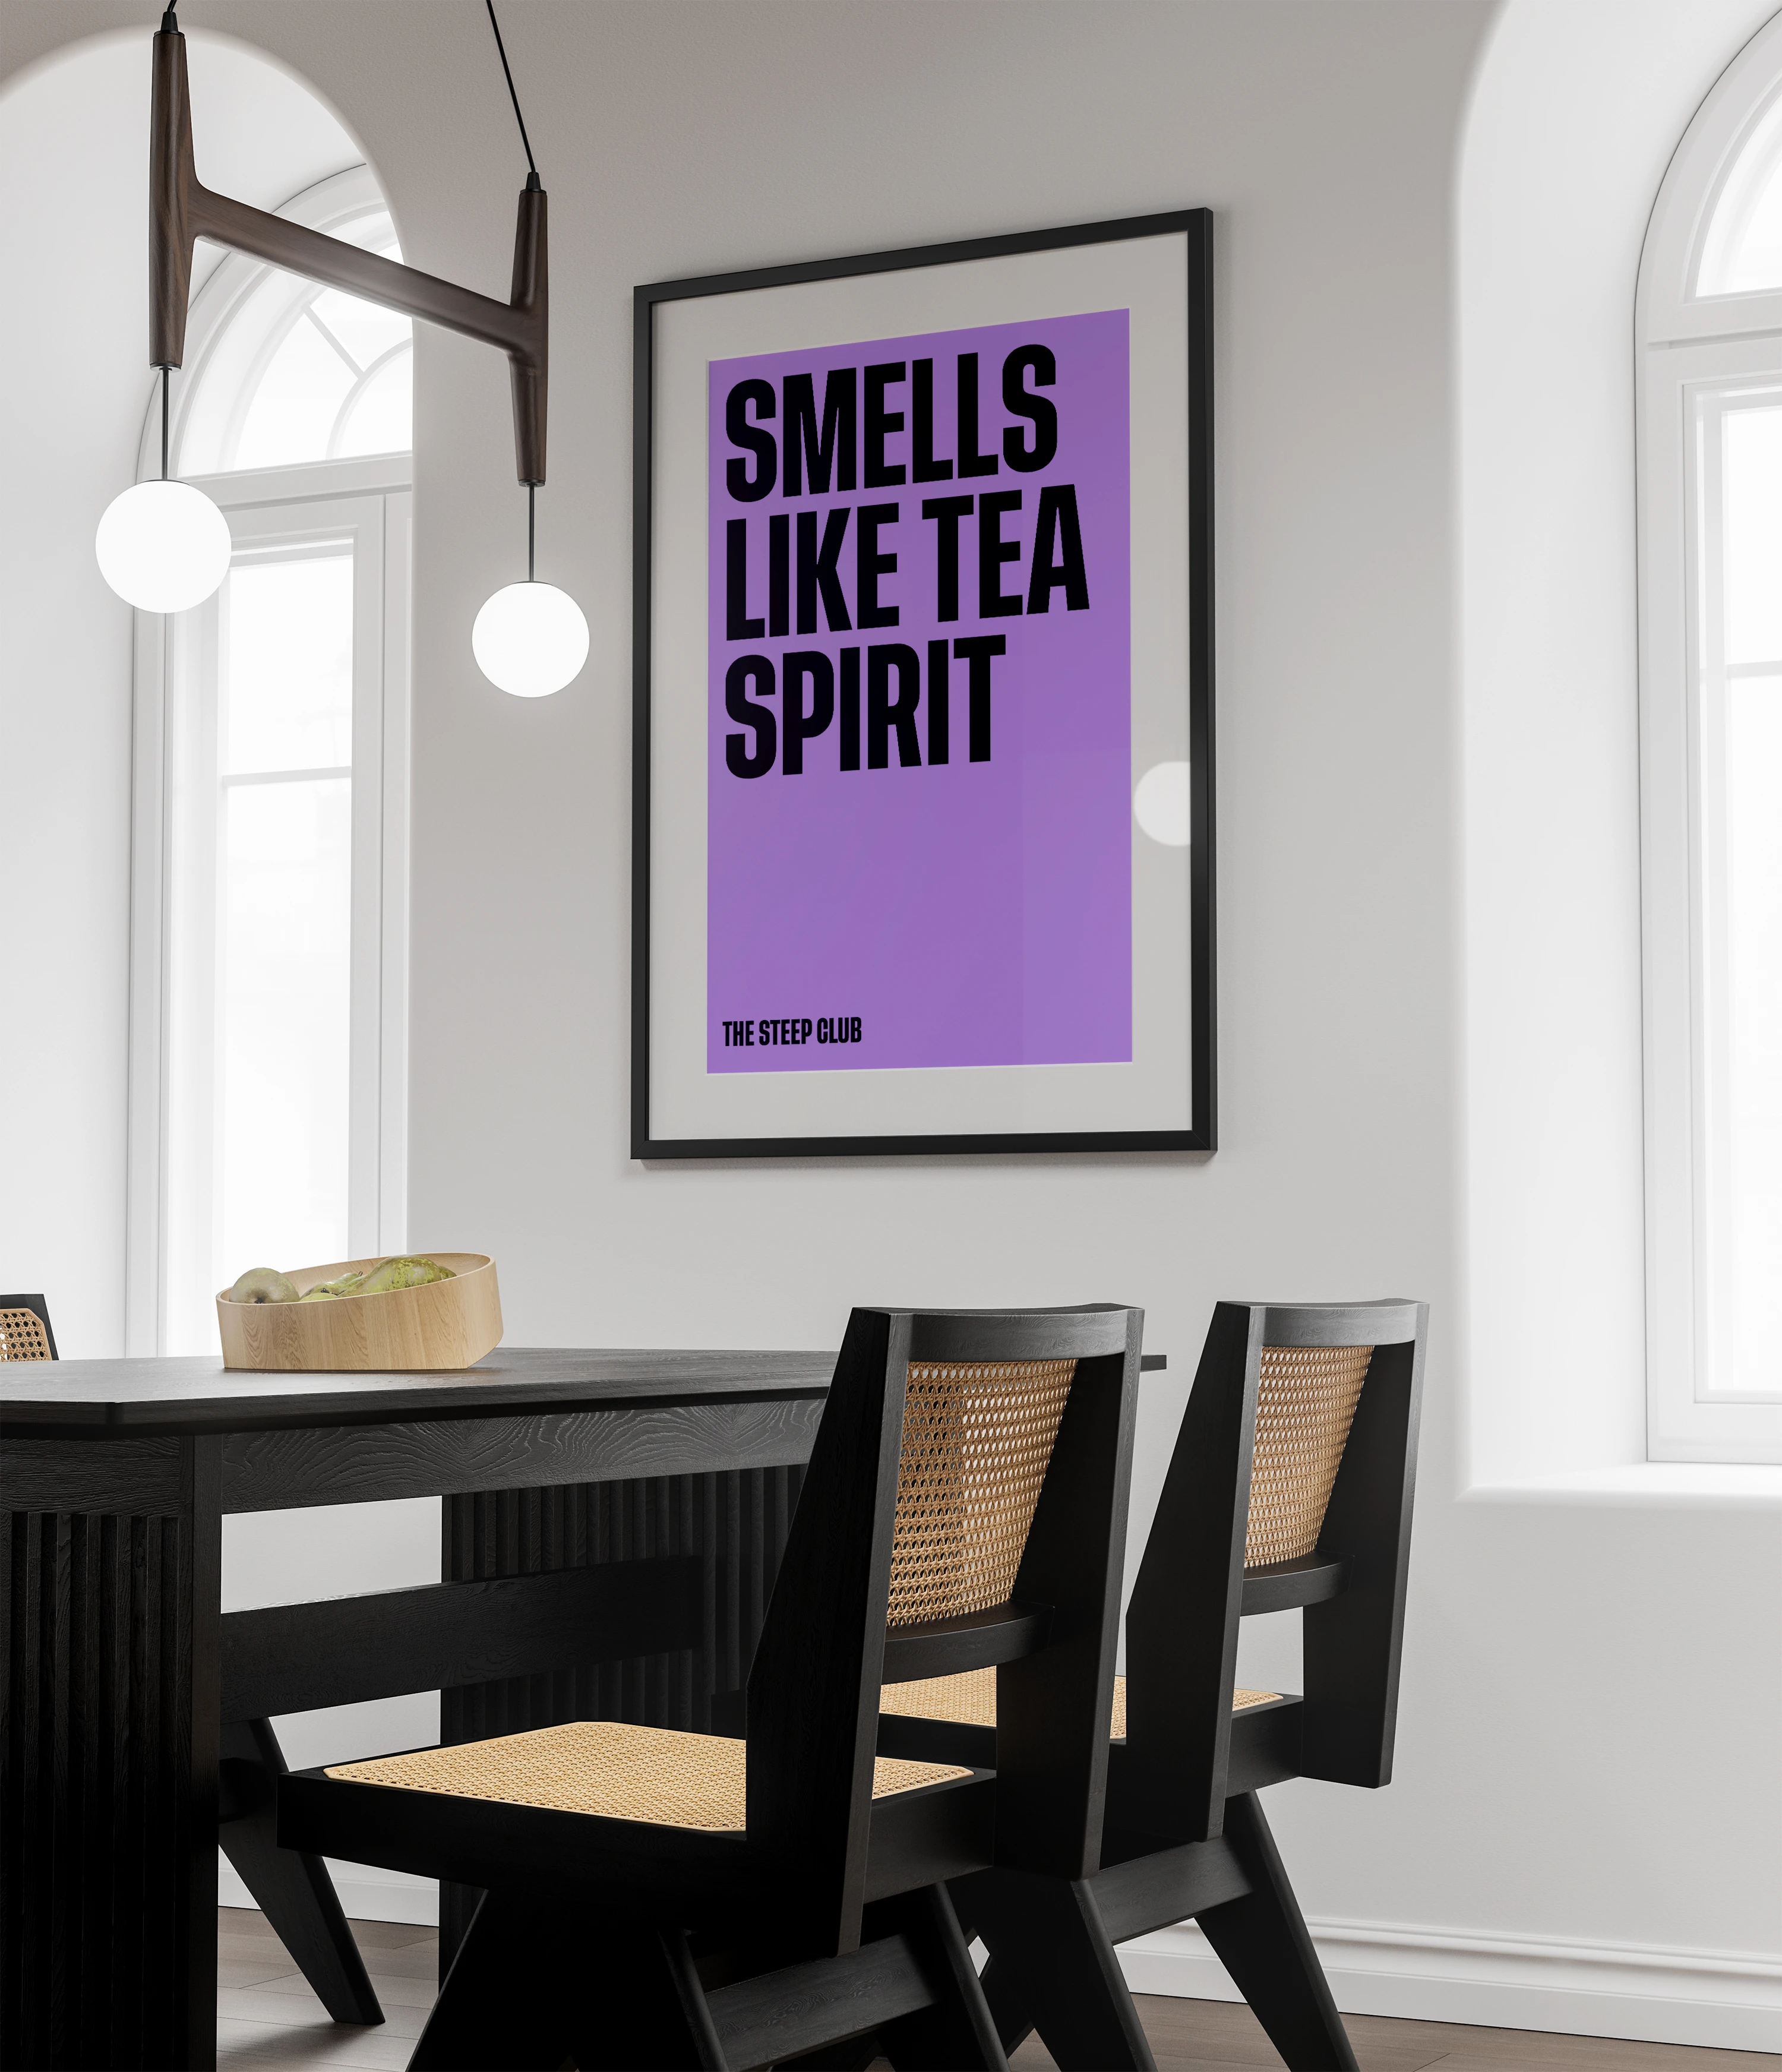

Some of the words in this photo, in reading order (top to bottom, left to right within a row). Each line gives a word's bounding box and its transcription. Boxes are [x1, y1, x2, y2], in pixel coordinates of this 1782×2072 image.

[725, 344, 1058, 503] SMELLS
[726, 502, 899, 641] LIKE
[922, 484, 1090, 623] TEA
[725, 634, 1006, 779] SPIRIT
[722, 1020, 754, 1047] THE
[759, 1018, 813, 1046] STEEP
[817, 1016, 862, 1044] CLUB
